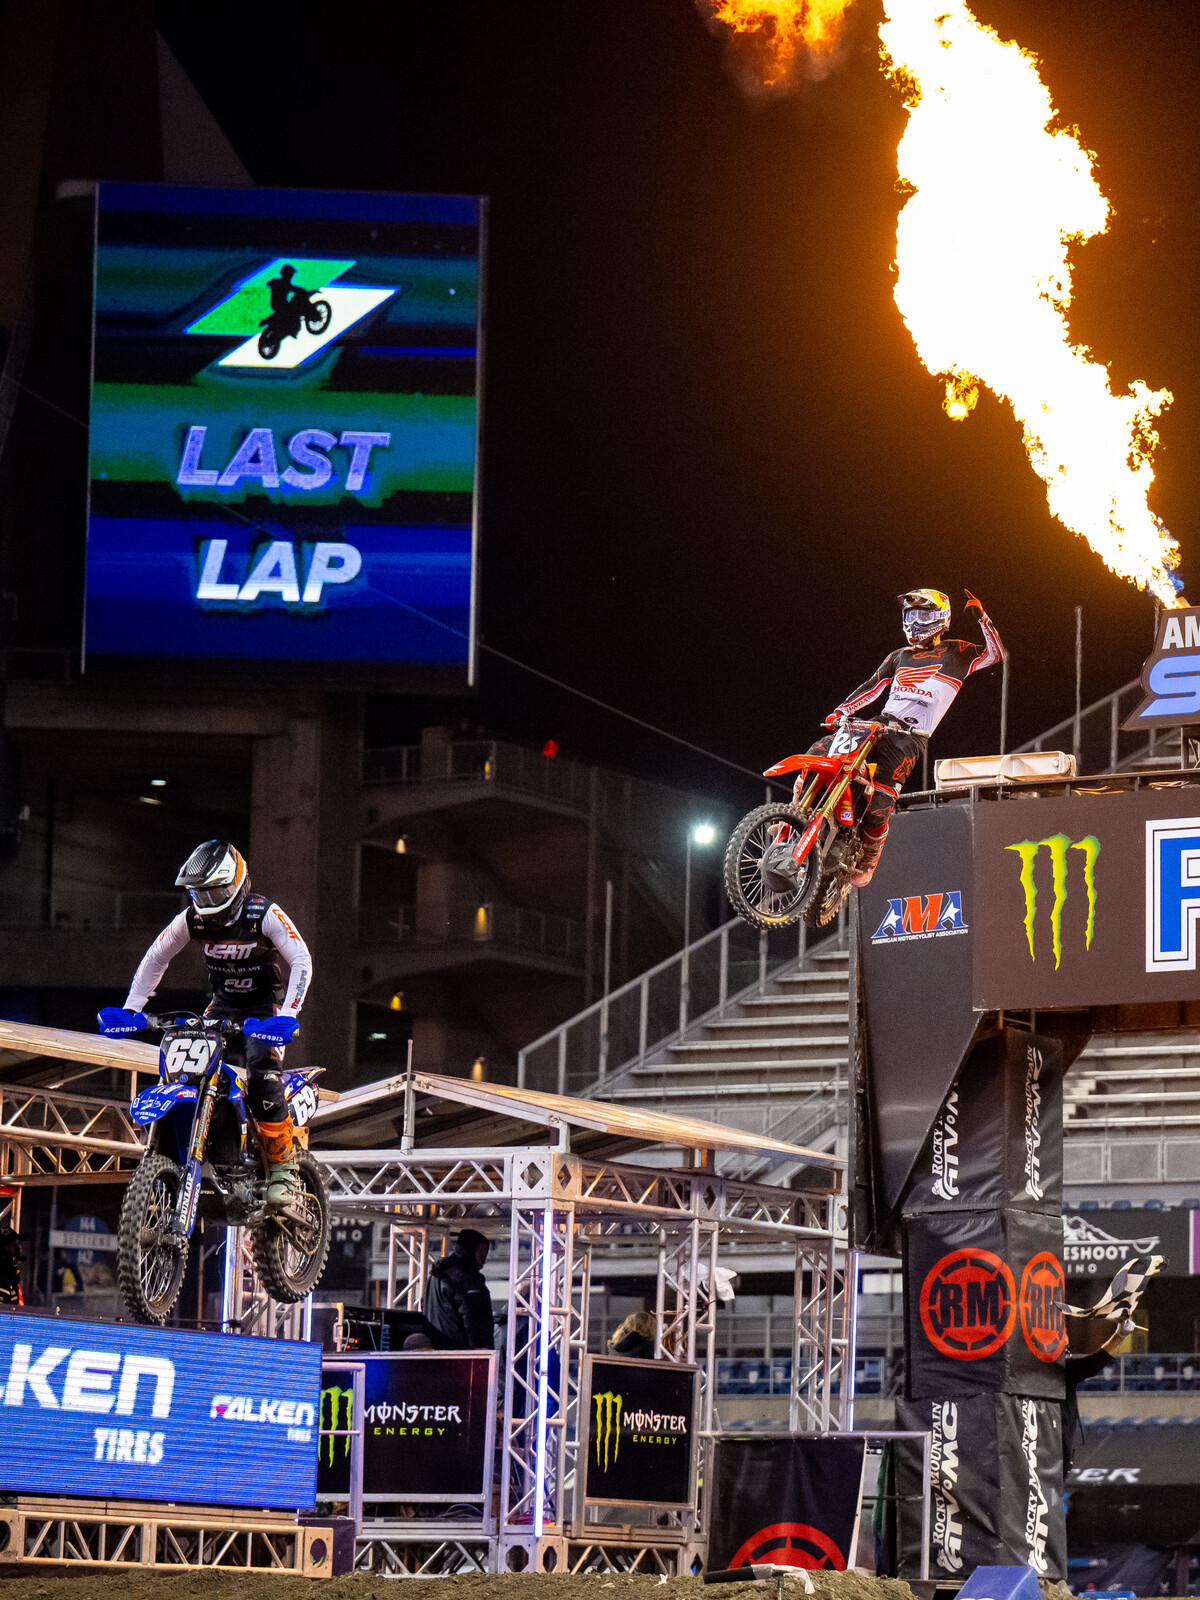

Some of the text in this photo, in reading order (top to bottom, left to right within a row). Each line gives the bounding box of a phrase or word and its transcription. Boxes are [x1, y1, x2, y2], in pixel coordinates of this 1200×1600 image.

[177, 425, 391, 490] LAST
[196, 539, 362, 603] LAP
[893, 686, 933, 698] HONDA
[797, 825, 816, 857] DUNLOP
[871, 891, 968, 938] AMA
[204, 942, 257, 960] LEATT
[872, 929, 968, 945] AMERICAN MOTORCYCLIST ASSOCIATION
[224, 978, 253, 988] FLO
[104, 1026, 137, 1034] ACERBIS
[251, 1032, 283, 1041] ACERBIS
[165, 1038, 217, 1073] 69
[290, 1085, 317, 1127] 69
[931, 1128, 943, 1177] ROCKY
[1024, 1126, 1034, 1177] ROCKY
[179, 1172, 193, 1224] DUNLOP
[939, 1281, 1001, 1328] RM
[0, 1343, 176, 1418] KEN
[210, 1395, 315, 1426] FALKEN
[623, 1409, 688, 1433] MONSTER
[94, 1427, 166, 1465] TIRES
[374, 1427, 446, 1436] ENERGY
[633, 1434, 678, 1445] ENERGY
[930, 1401, 944, 1546] ROCKY MOUNTAIN
[1072, 1468, 1141, 1482] ER
[1024, 1491, 1038, 1547] ROCKY
